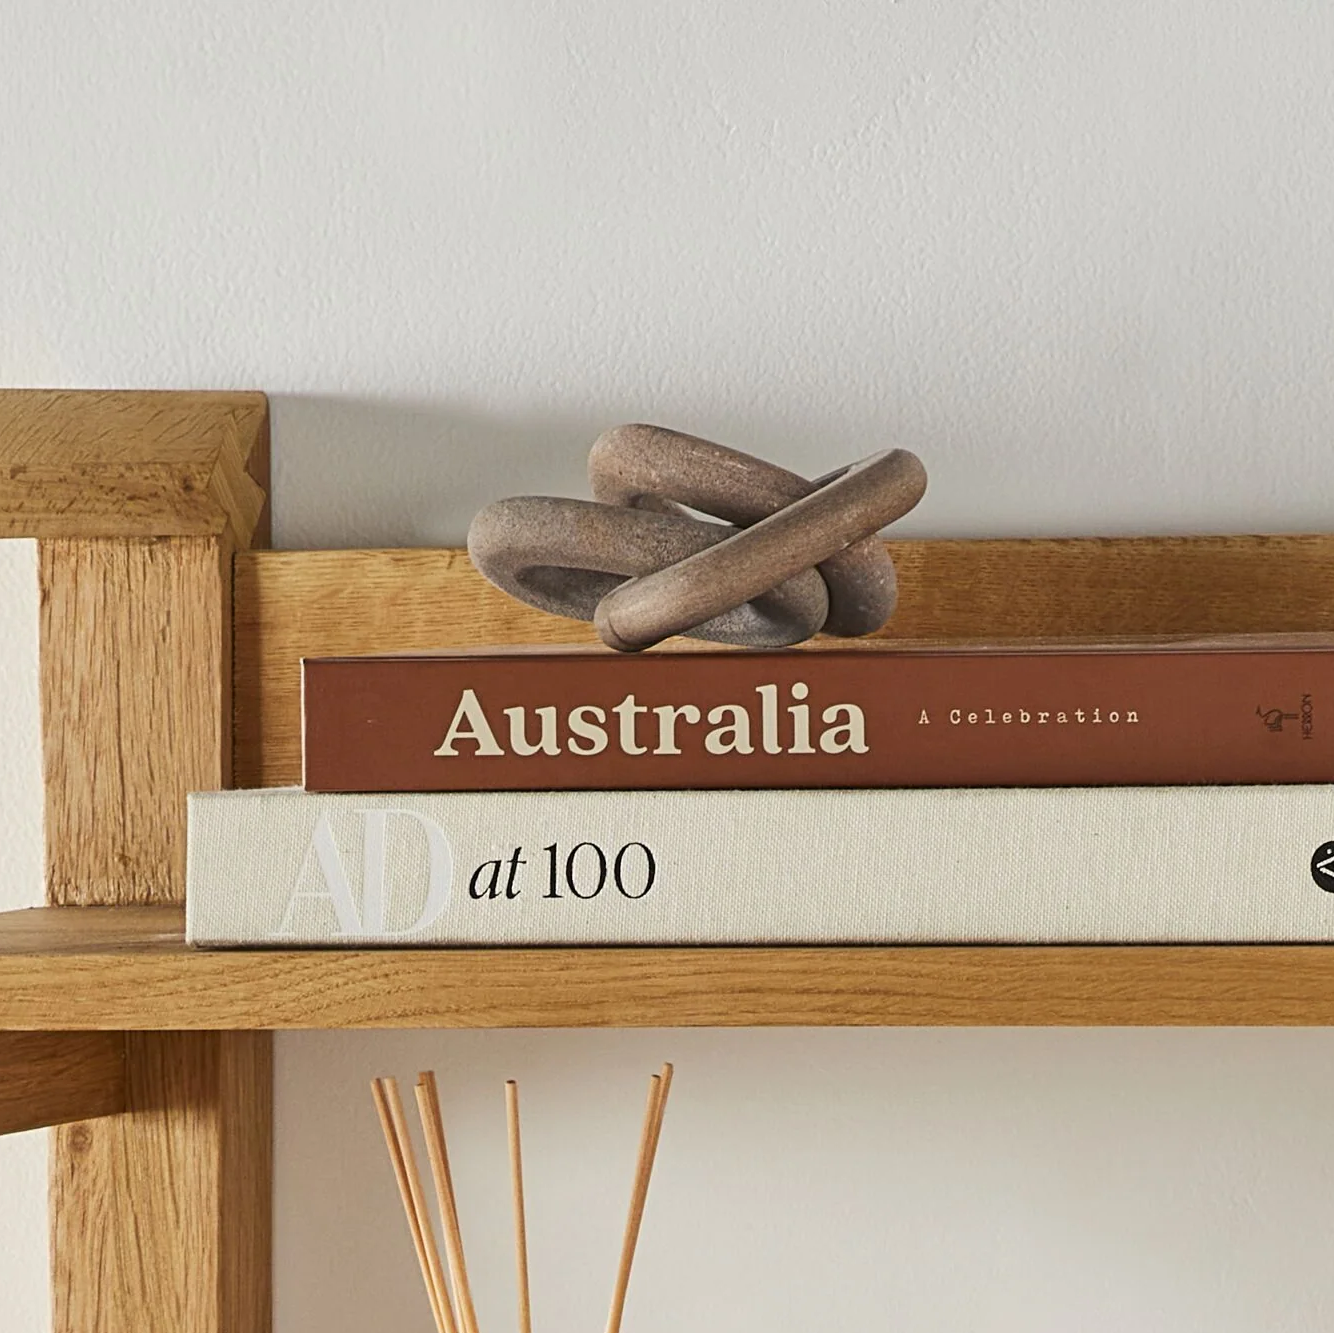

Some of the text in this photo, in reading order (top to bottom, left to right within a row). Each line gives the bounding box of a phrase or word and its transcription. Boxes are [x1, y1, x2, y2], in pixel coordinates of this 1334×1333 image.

[432, 682, 871, 757] Australia
[918, 707, 1141, 726] A Celebration
[268, 807, 657, 938] AD at 100
